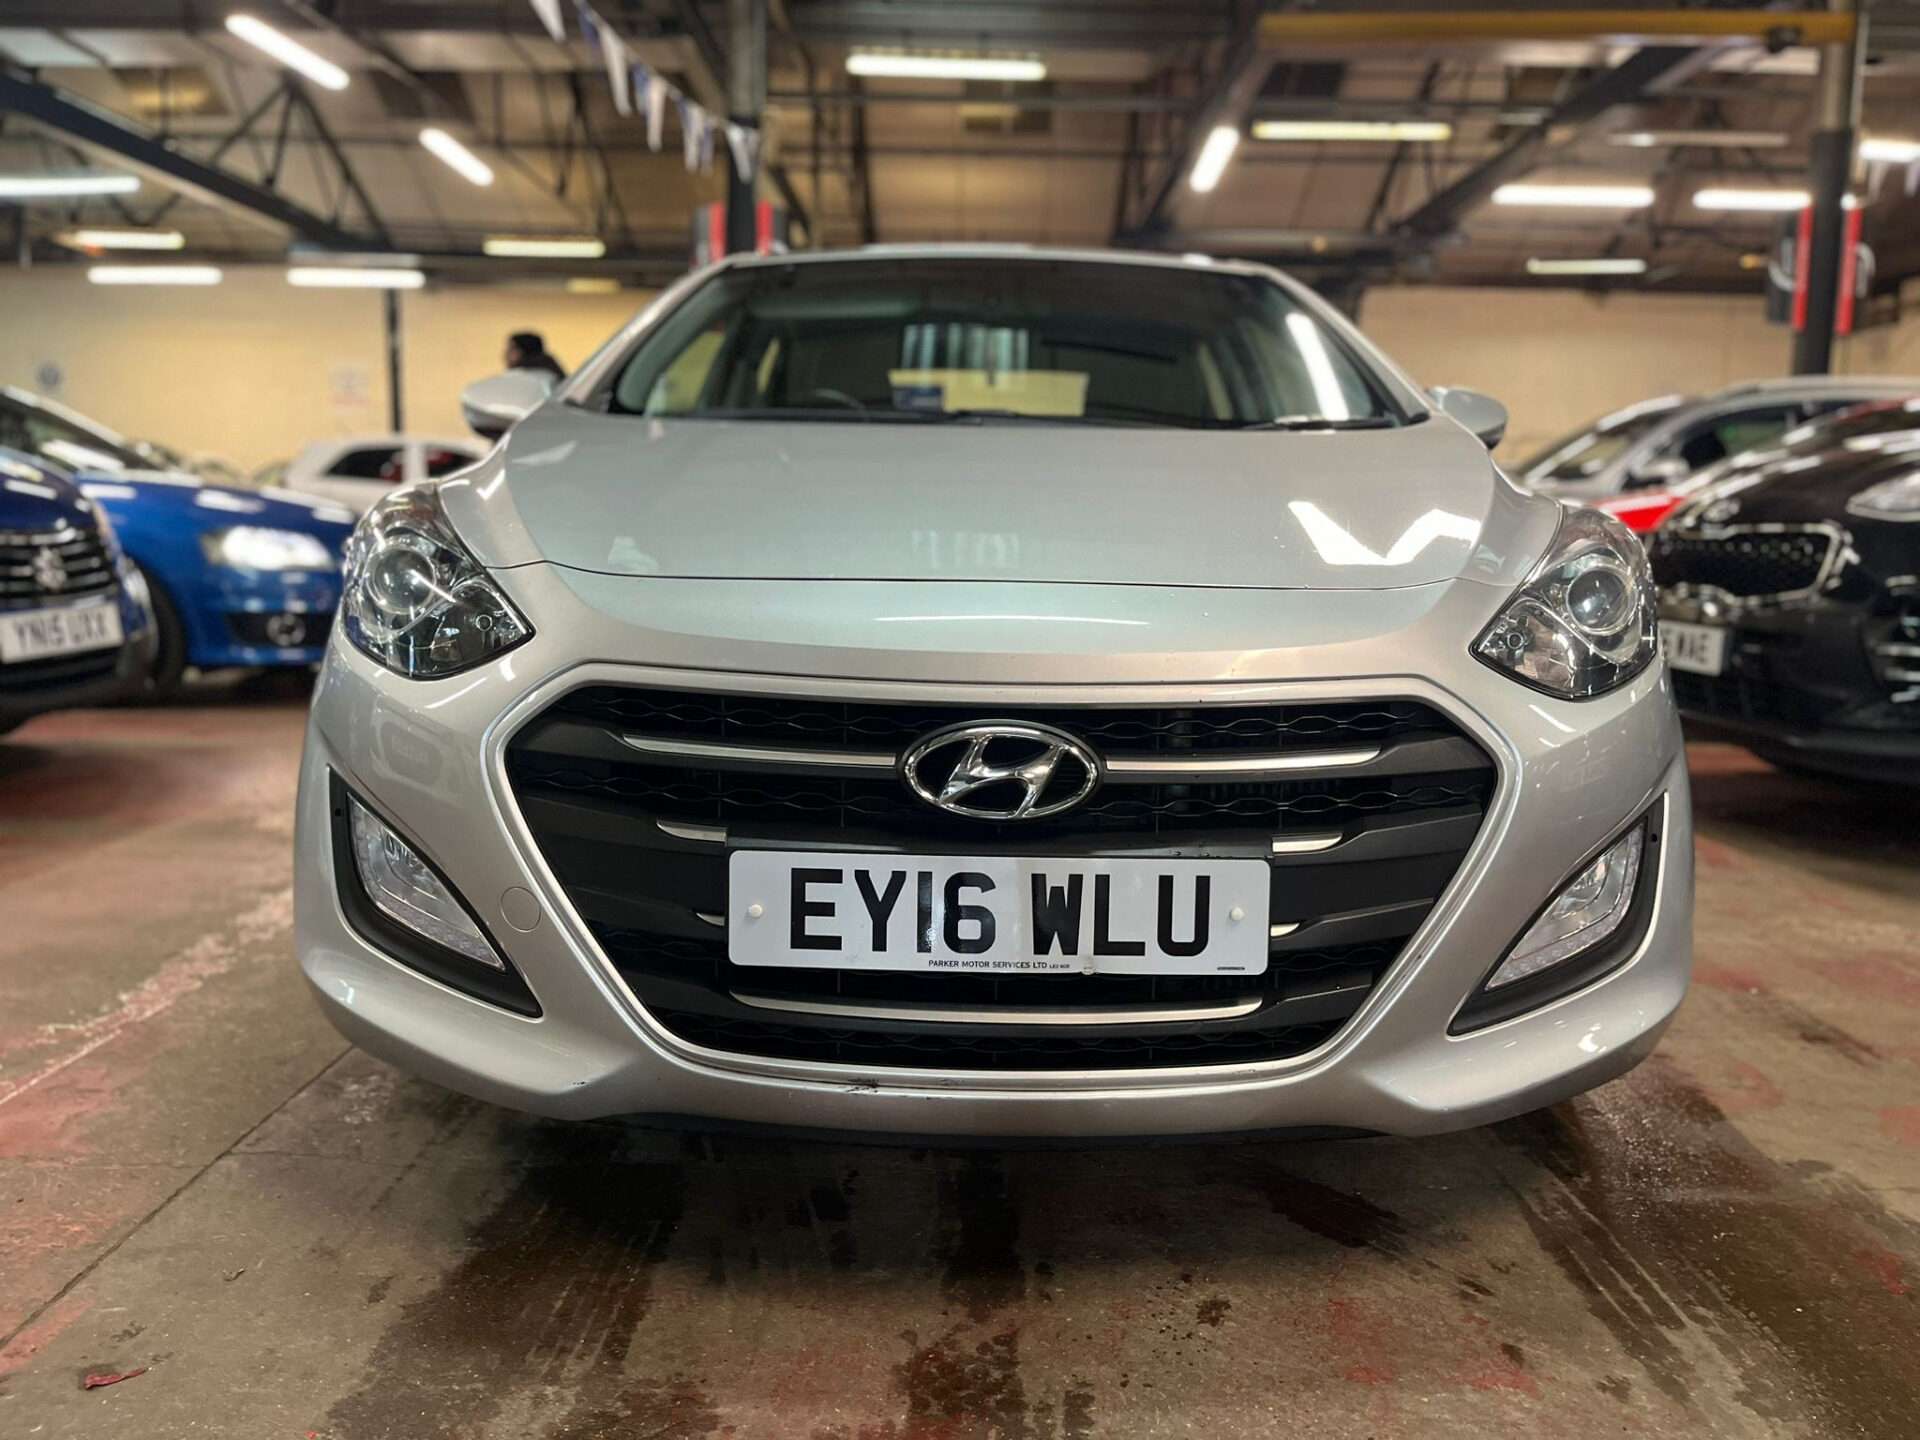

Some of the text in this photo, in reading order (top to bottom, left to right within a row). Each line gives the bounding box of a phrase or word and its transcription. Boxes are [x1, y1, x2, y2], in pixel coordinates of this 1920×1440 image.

[790, 867, 1212, 957] EY16 WLU
[928, 959, 959, 968] PARKER
[961, 960, 990, 968] MOTOR
[992, 961, 1031, 969] SERVICES
[1033, 961, 1048, 969] LTD
